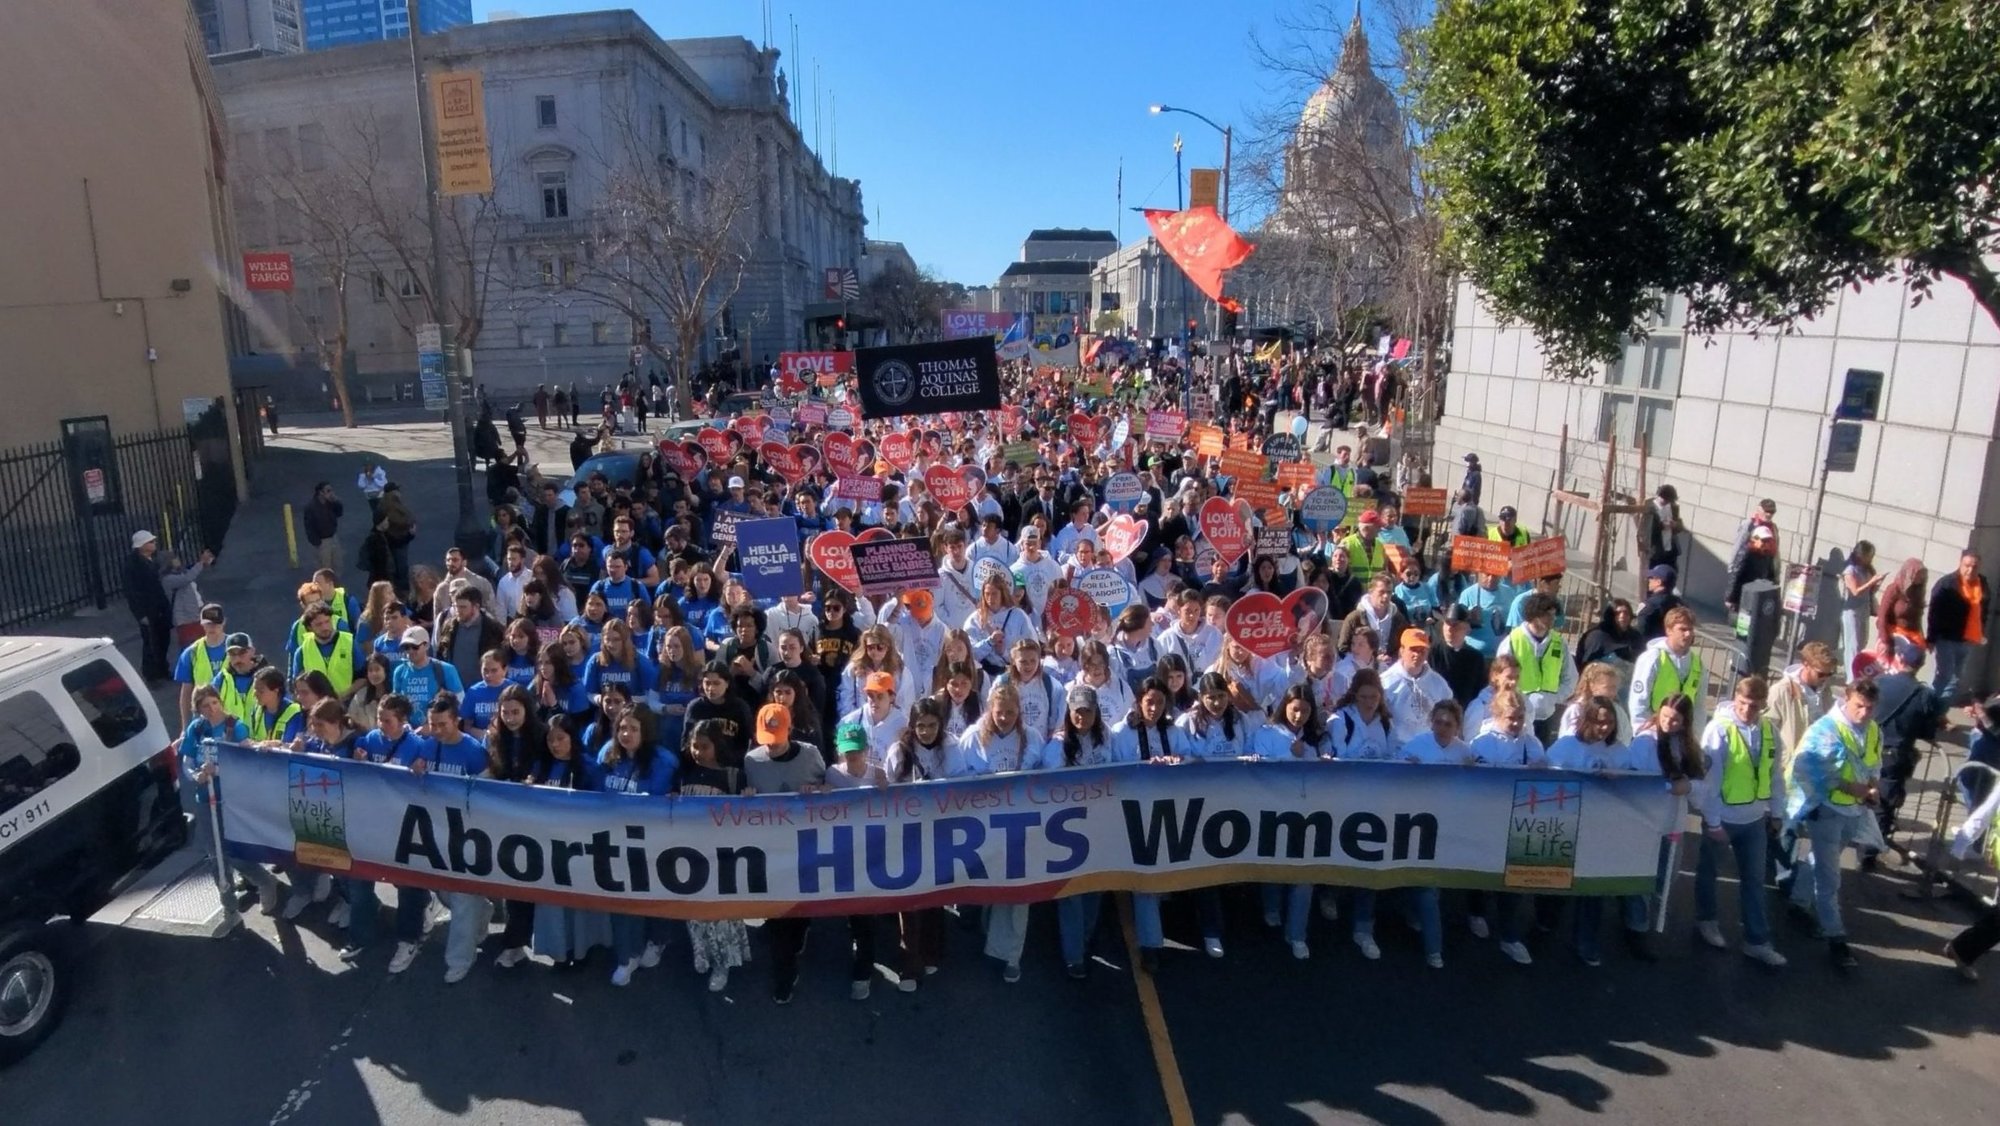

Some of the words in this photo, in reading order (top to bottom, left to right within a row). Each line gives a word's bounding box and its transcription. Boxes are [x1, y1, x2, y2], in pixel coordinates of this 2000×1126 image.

[248, 261, 288, 271] WELLS
[250, 272, 290, 282] FARGO
[947, 314, 986, 328] LOVE
[787, 356, 834, 372] LOVE
[918, 357, 976, 373] THOMAS
[920, 370, 978, 387] AQUINAS
[920, 382, 981, 398] COLLEGE
[1150, 413, 1183, 424] DEFUND
[828, 440, 852, 453] LOVE
[886, 442, 907, 451] LOVE
[1266, 447, 1298, 457] HUMAN
[766, 450, 792, 461] LOVE
[828, 450, 855, 466] BOTH
[888, 450, 911, 459] BOTH
[771, 457, 799, 470] BOTH
[841, 477, 881, 488] DEFUND
[930, 477, 956, 486] LOVE
[935, 486, 965, 497] BOTH
[1206, 513, 1234, 524] LOVE
[1210, 527, 1241, 538] BOTH
[1257, 538, 1289, 547] PRO-LIFE
[1459, 540, 1502, 551] ABORTION
[748, 543, 788, 555] HELLA
[820, 546, 850, 557] LOV
[865, 543, 917, 555] PLANNED
[742, 553, 797, 566] PRO-LIFE
[856, 550, 930, 565] PARENTHOOD
[826, 559, 853, 569] BOT
[860, 563, 890, 575] KILLS
[891, 559, 933, 571] BABIES
[982, 560, 1002, 571] PRAY
[979, 566, 988, 574] TO
[862, 572, 906, 581] TRANSITIONS
[1095, 587, 1127, 597] ABORTO
[1236, 610, 1283, 625] LOVE
[1239, 626, 1290, 638] BOTH
[407, 677, 429, 685] LOVE
[406, 685, 428, 693] THEM
[291, 798, 332, 818] Walk
[709, 802, 796, 827] Walk
[805, 799, 851, 825] for
[866, 792, 922, 819] Life
[936, 786, 1016, 813] West
[1026, 778, 1114, 806] Coast
[25, 799, 50, 823] 911
[302, 817, 343, 839] Life
[1515, 816, 1565, 834] Walk
[394, 803, 768, 895] Abortion
[797, 806, 1091, 894] HURTS
[1121, 797, 1439, 867] Women
[1524, 834, 1573, 857] Life
